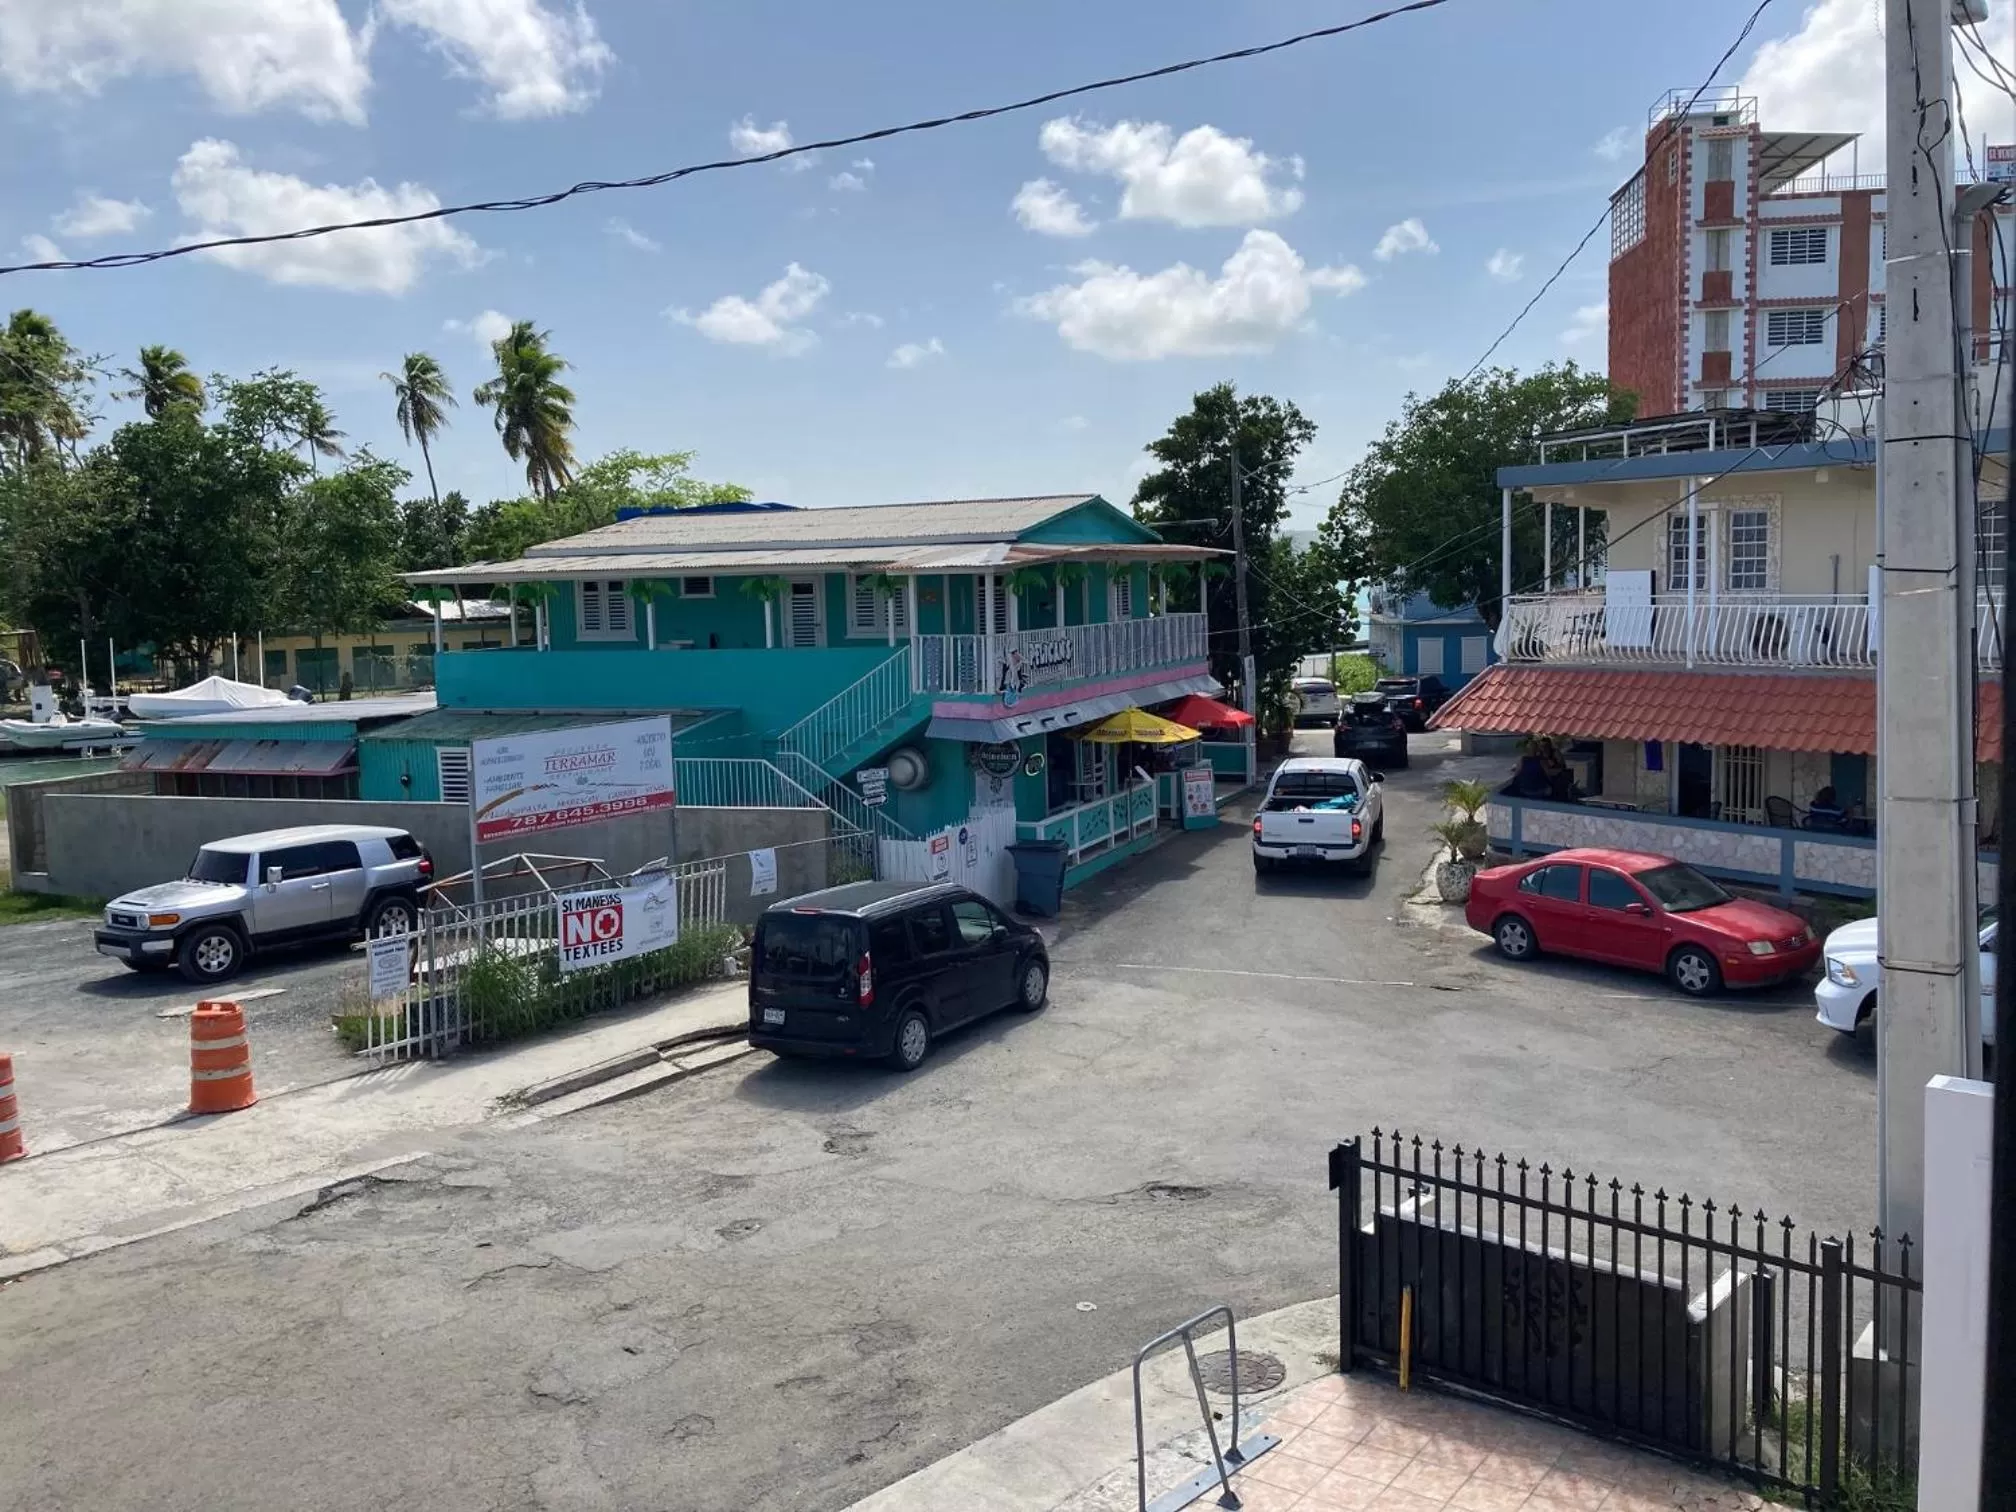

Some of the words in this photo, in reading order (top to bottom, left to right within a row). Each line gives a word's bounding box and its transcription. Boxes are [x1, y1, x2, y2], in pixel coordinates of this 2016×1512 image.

[544, 752, 616, 771] TERRAMAR
[562, 900, 573, 912] SI
[576, 893, 622, 910] MANEJAS
[567, 908, 620, 945] NO
[563, 939, 623, 961] TEXTEES
